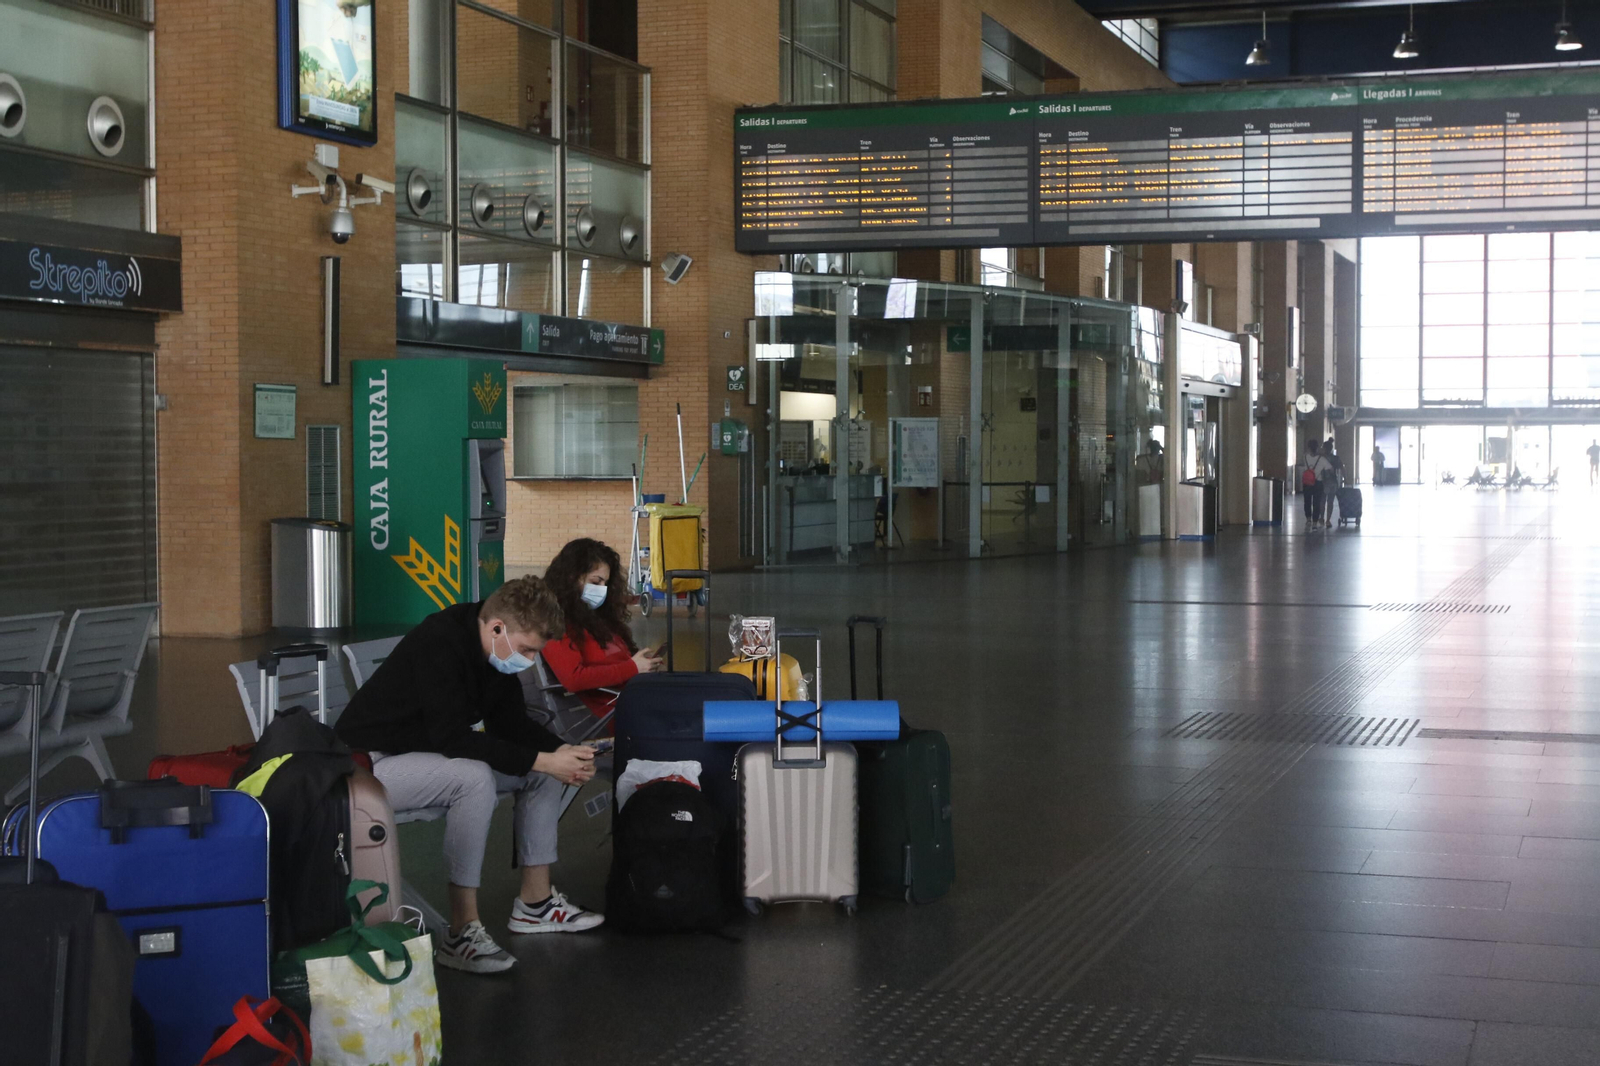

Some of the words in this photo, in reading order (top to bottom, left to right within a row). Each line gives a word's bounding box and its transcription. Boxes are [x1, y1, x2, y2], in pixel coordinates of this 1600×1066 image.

[1363, 88, 1406, 100] Llegadas
[1415, 89, 1442, 97] ARRIVALS
[1039, 104, 1071, 114] Salidas
[740, 117, 770, 127] Salidas
[1269, 121, 1310, 129] Observaciones
[952, 134, 991, 142] Observaciones
[29, 247, 128, 303] Strepito
[542, 324, 560, 338] Salida
[590, 329, 603, 343] Pago
[604, 331, 639, 345] aparcamiento
[369, 369, 388, 470] RURAL
[370, 477, 389, 551] CAJA
[549, 909, 567, 923] N
